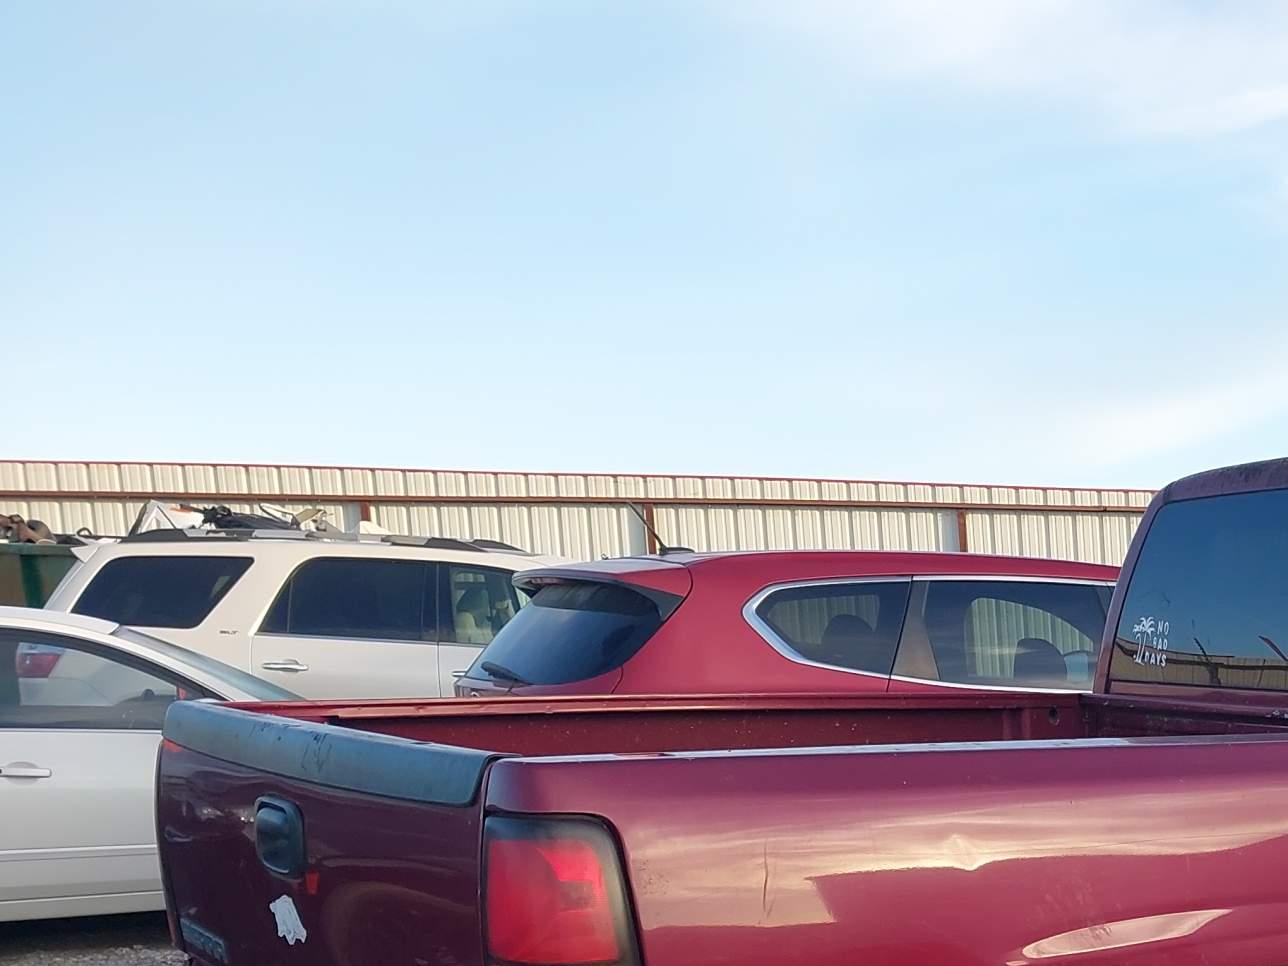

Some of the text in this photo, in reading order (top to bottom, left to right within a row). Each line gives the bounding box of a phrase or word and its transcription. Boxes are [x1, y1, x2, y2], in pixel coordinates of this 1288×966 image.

[1157, 620, 1170, 636] NO
[1152, 636, 1168, 650] BAD
[1144, 651, 1167, 667] DAYS
